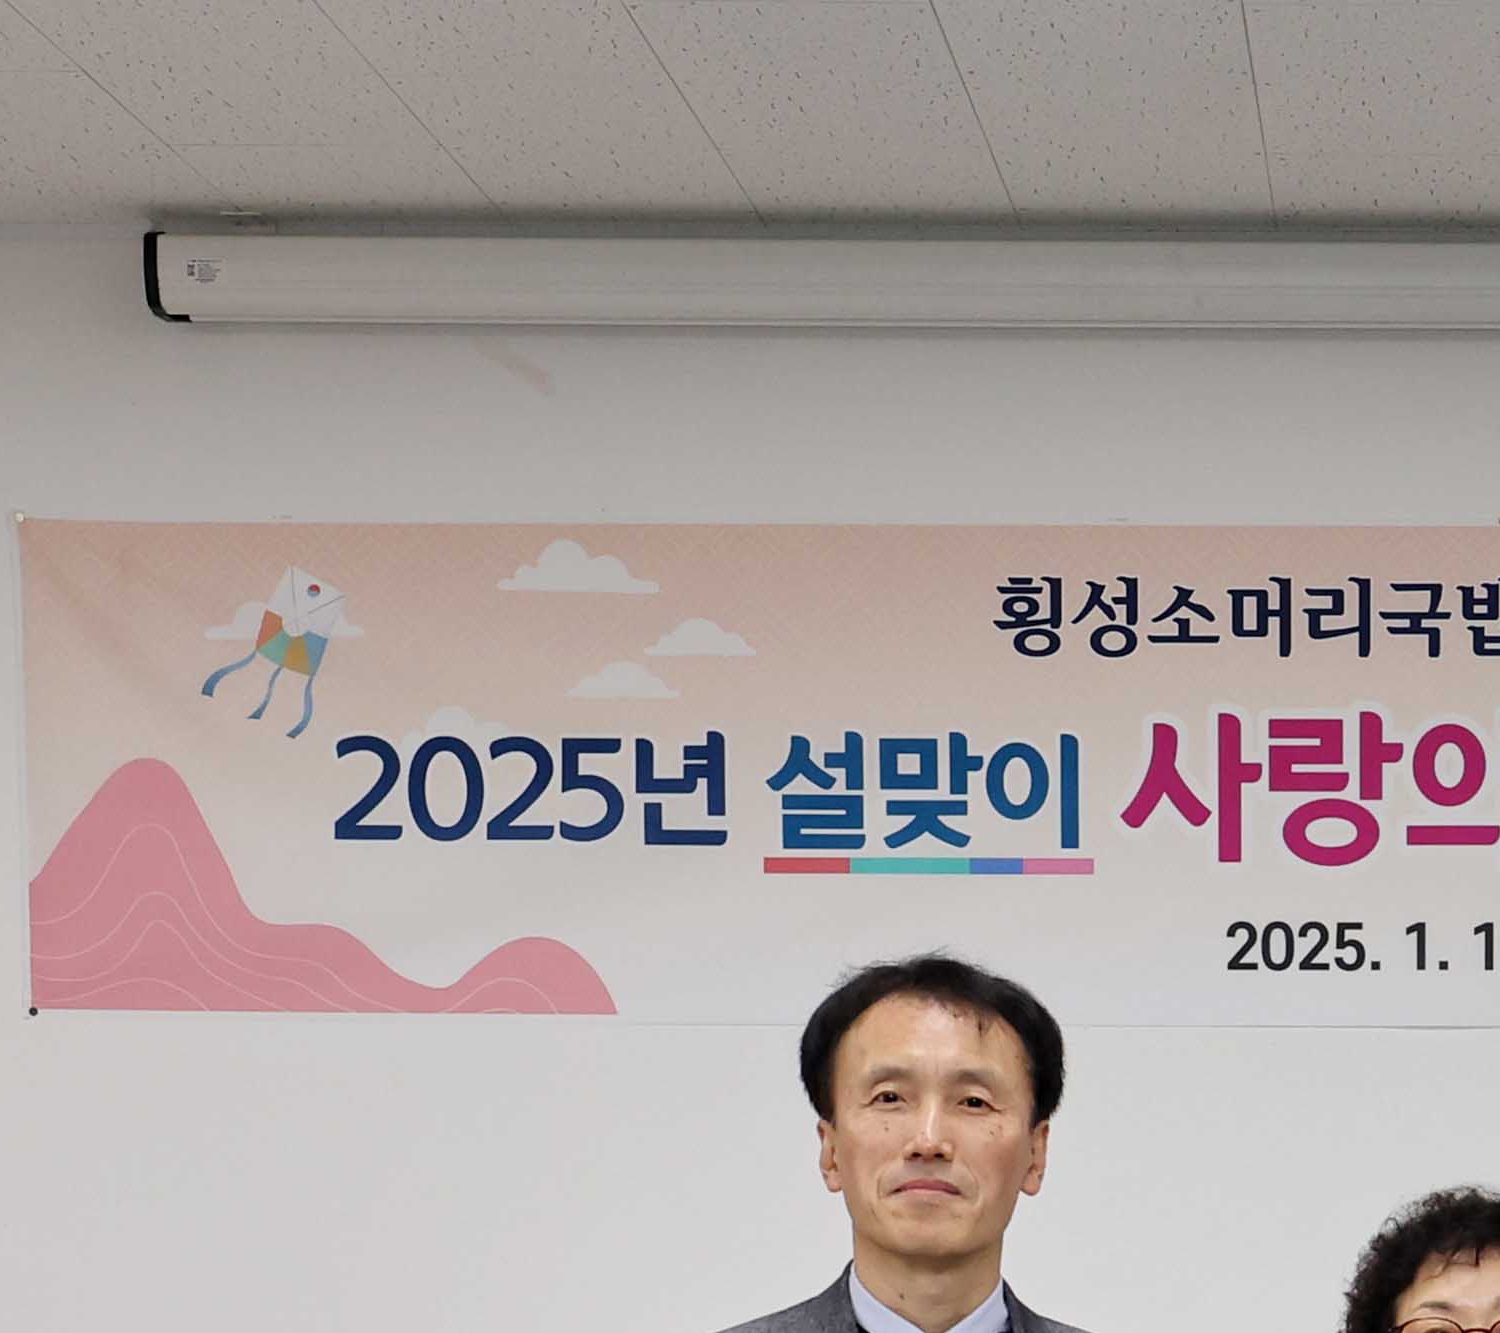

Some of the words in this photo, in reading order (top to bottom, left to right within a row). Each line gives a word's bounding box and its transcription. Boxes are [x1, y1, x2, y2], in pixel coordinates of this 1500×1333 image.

[334, 730, 728, 847] 2025년
[764, 731, 1083, 853] 설맞이
[1226, 920, 1381, 972] 2025.
[1405, 921, 1449, 971] 1.
